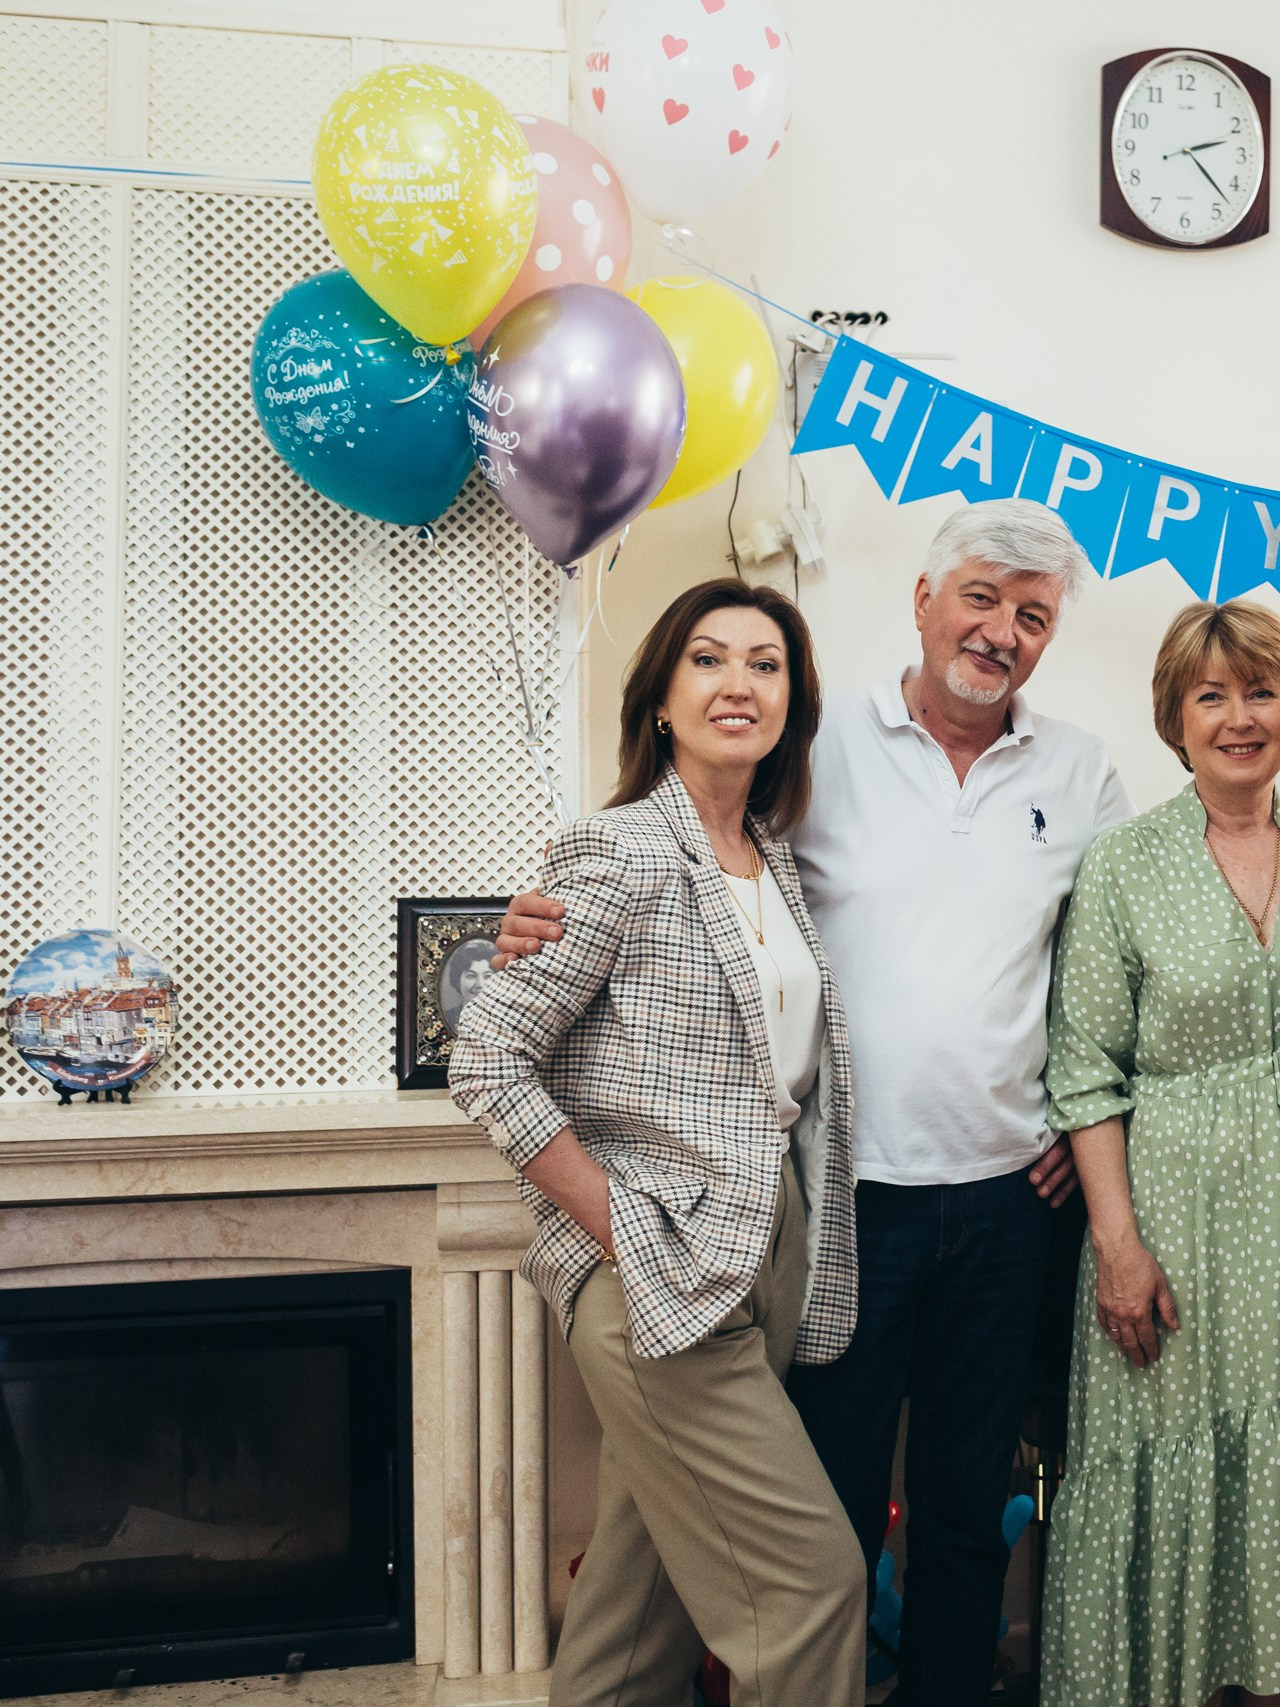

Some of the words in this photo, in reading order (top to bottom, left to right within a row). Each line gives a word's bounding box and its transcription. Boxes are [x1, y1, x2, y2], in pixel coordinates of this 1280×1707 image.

[1176, 74, 1196, 92] 12
[1146, 86, 1164, 104] 11
[1213, 91, 1223, 109] 1
[1130, 112, 1149, 130] 10
[1230, 116, 1242, 134] 2
[1124, 139, 1136, 156] 9
[1235, 146, 1247, 165] 3
[361, 160, 374, 179] С
[377, 160, 436, 180] ДНЕМ
[1129, 168, 1141, 187] 8
[349, 179, 460, 204] РОЖДЕНИЯ!
[1228, 175, 1240, 192] 4
[1150, 196, 1163, 214] 7
[1210, 203, 1223, 220] 5
[1179, 211, 1191, 229] 6
[266, 362, 278, 385] С
[280, 355, 333, 383] Днём
[264, 369, 351, 409] Рождения!
